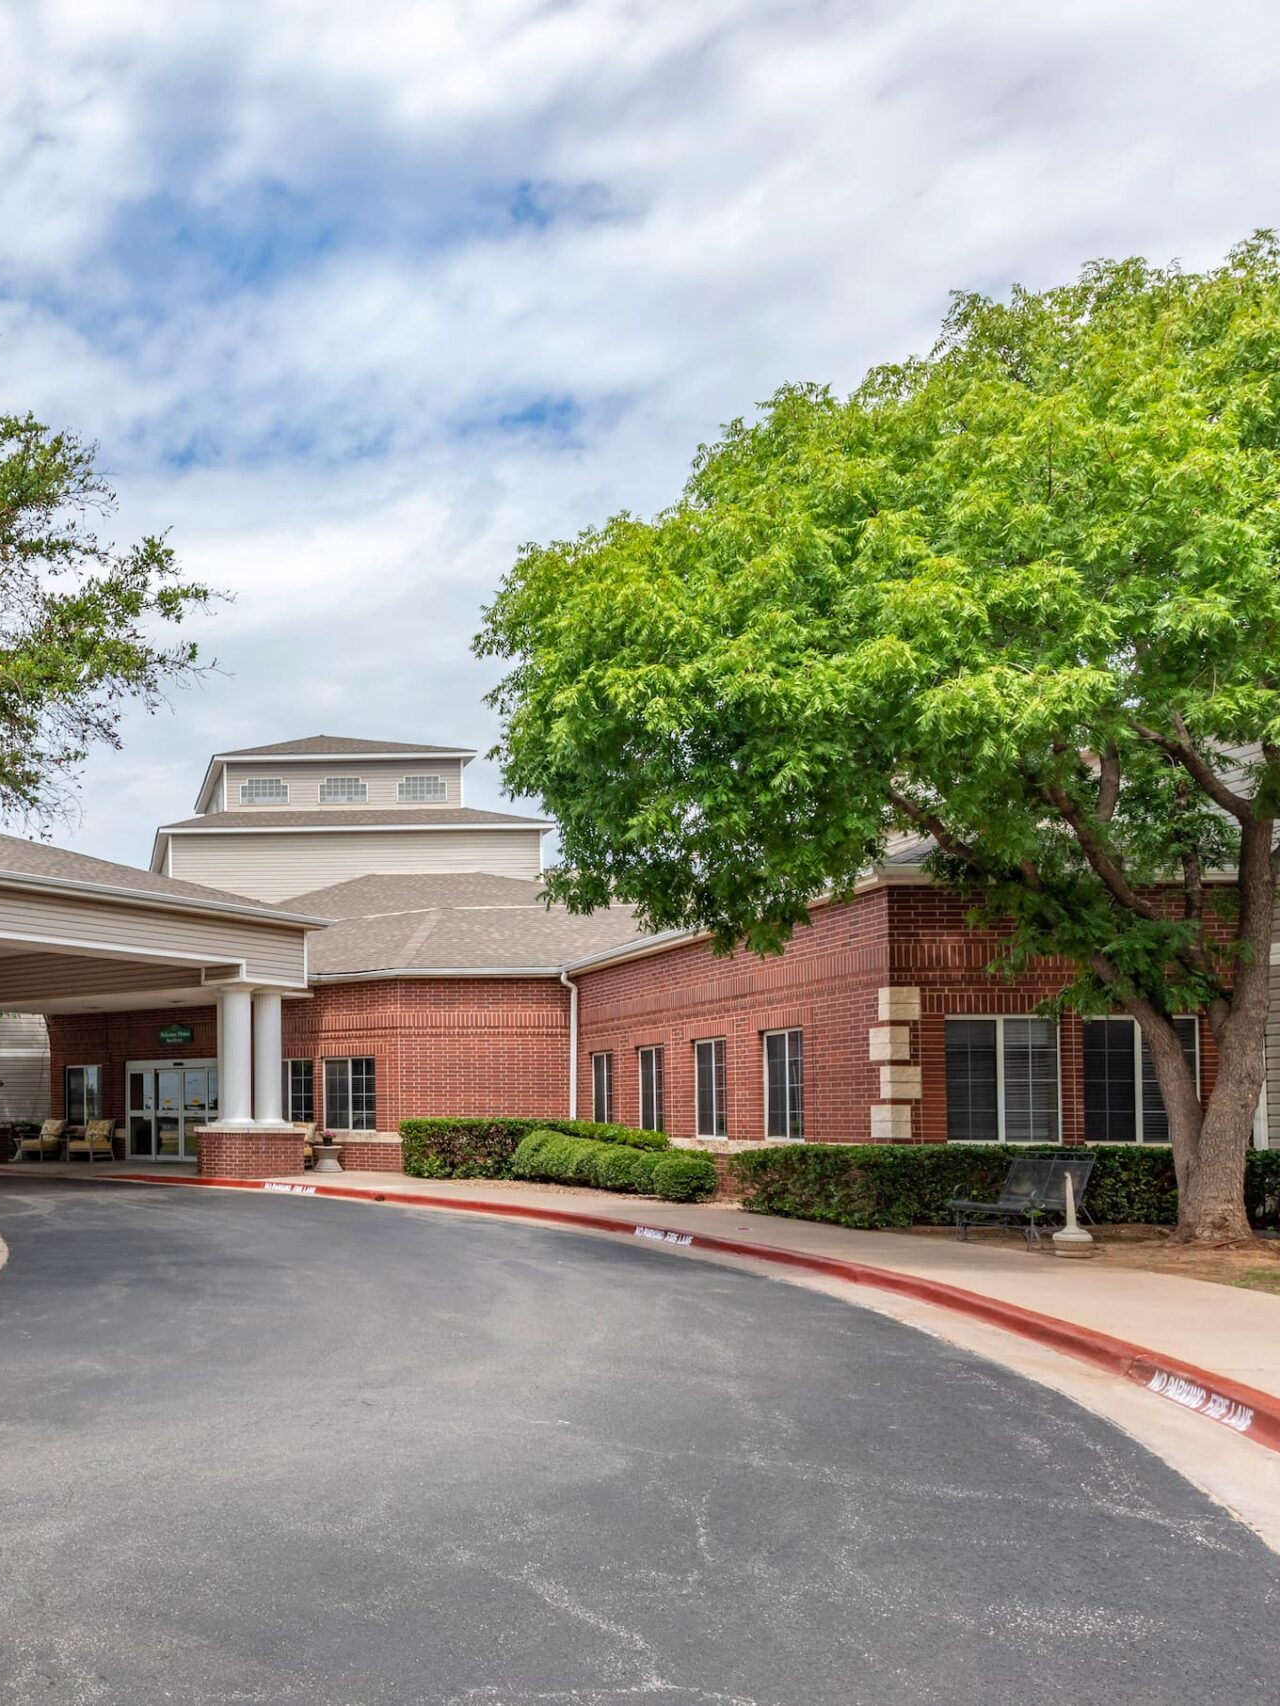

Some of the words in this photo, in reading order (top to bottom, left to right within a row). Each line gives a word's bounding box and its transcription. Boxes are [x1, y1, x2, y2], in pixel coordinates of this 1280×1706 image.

[634, 1226, 644, 1236] NO
[642, 1227, 665, 1240] PARKING
[664, 1231, 679, 1244] FIRE
[676, 1234, 694, 1246] LANE
[1147, 1370, 1168, 1392] NO
[1160, 1375, 1207, 1410] PARKING
[1200, 1393, 1231, 1420] FIRE
[1220, 1401, 1255, 1432] LANE
